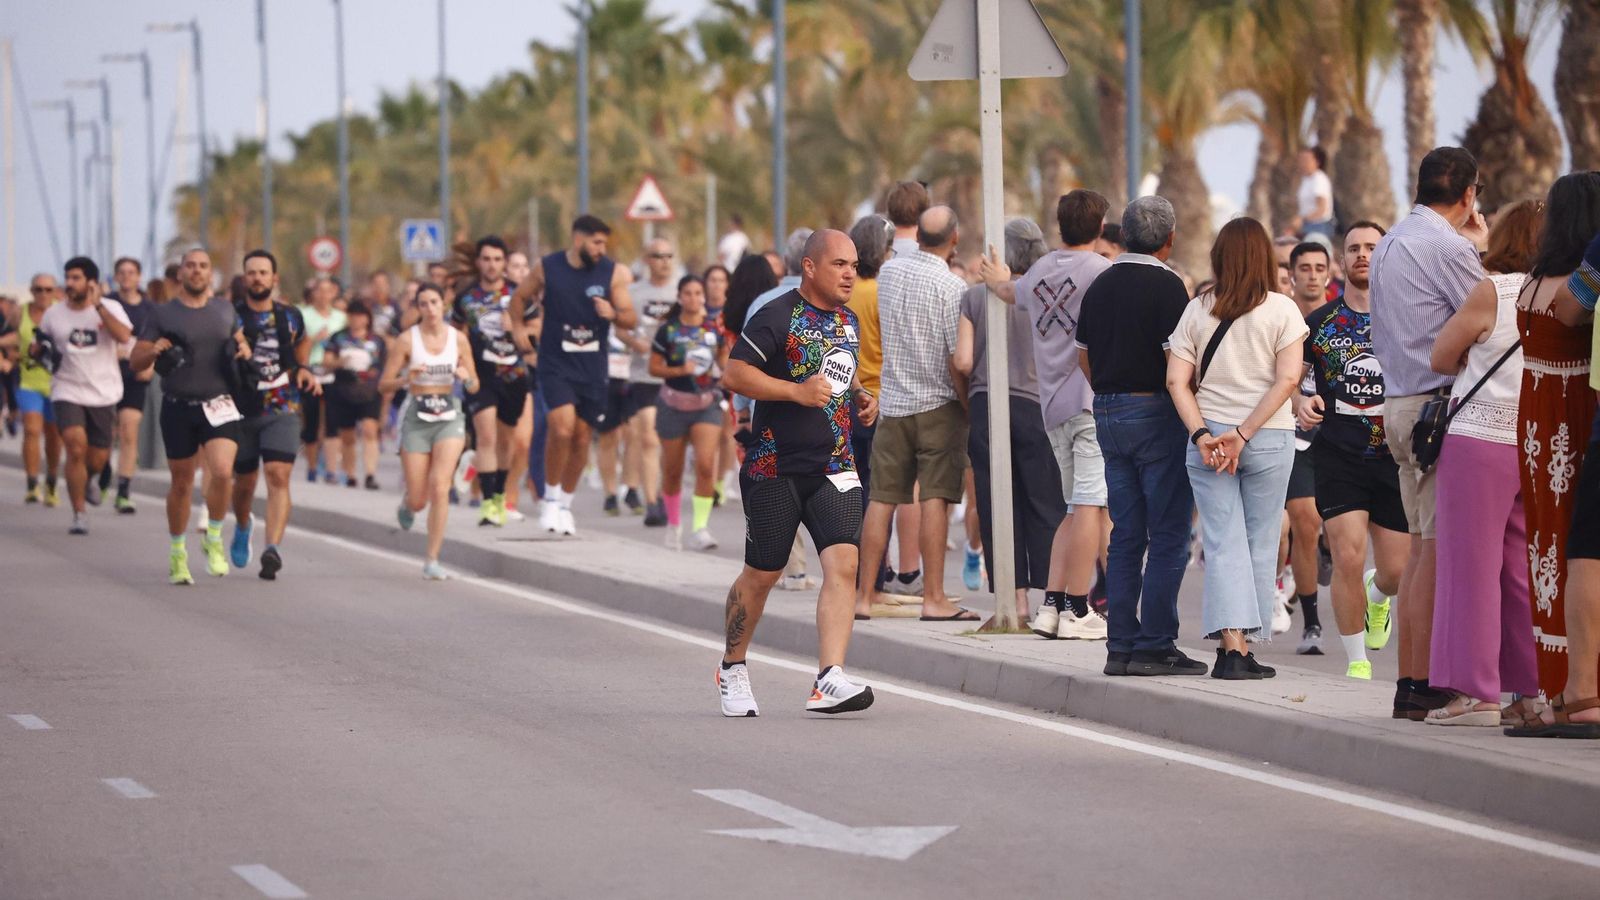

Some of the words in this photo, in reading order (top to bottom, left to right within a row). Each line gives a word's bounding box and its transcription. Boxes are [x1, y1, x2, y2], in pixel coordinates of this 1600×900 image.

[823, 367, 849, 384] FRENO
[826, 359, 853, 376] PONLE
[1344, 382, 1383, 396] 1048
